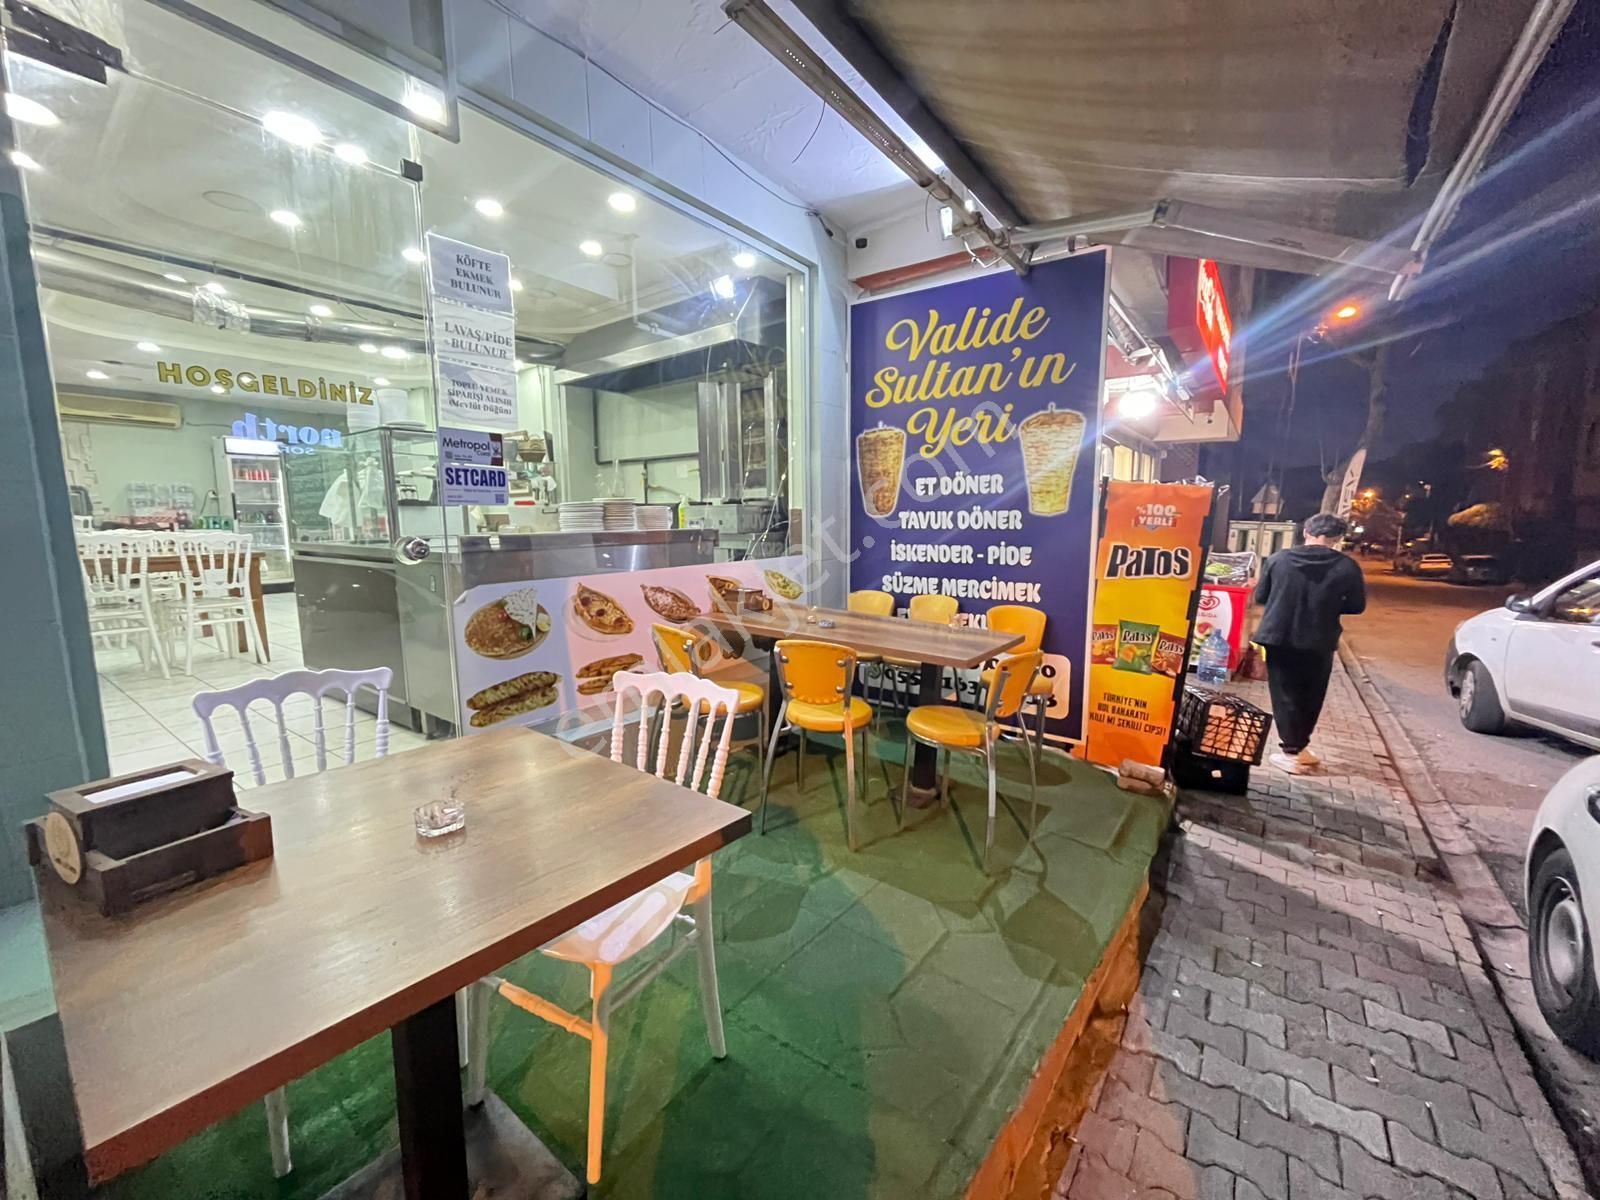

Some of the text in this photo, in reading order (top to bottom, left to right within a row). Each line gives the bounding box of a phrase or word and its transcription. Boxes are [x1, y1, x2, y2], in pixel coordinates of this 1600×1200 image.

[456, 254, 492, 272] KÖFTE
[456, 267, 494, 285] EKMEK
[450, 278, 501, 300] BULUNUR
[886, 297, 1050, 362] Valide
[452, 338, 507, 359] BULUNUR
[157, 361, 374, 405] HOŞGELDİNİZ
[865, 347, 1076, 408] Sultan'ın
[907, 403, 1016, 458] Yeri
[442, 437, 490, 452] Metropol
[445, 467, 506, 488] SETCARD
[915, 471, 1004, 497] ET DÖNER
[898, 505, 1023, 530] TAVUK DÖNER
[1138, 516, 1175, 527] YERLİ
[890, 539, 974, 564] İSKENDER
[987, 540, 1033, 567] PİDE
[882, 571, 1041, 604] SÜZME MERCİMEK
[1111, 705, 1149, 721] BAHARATLI
